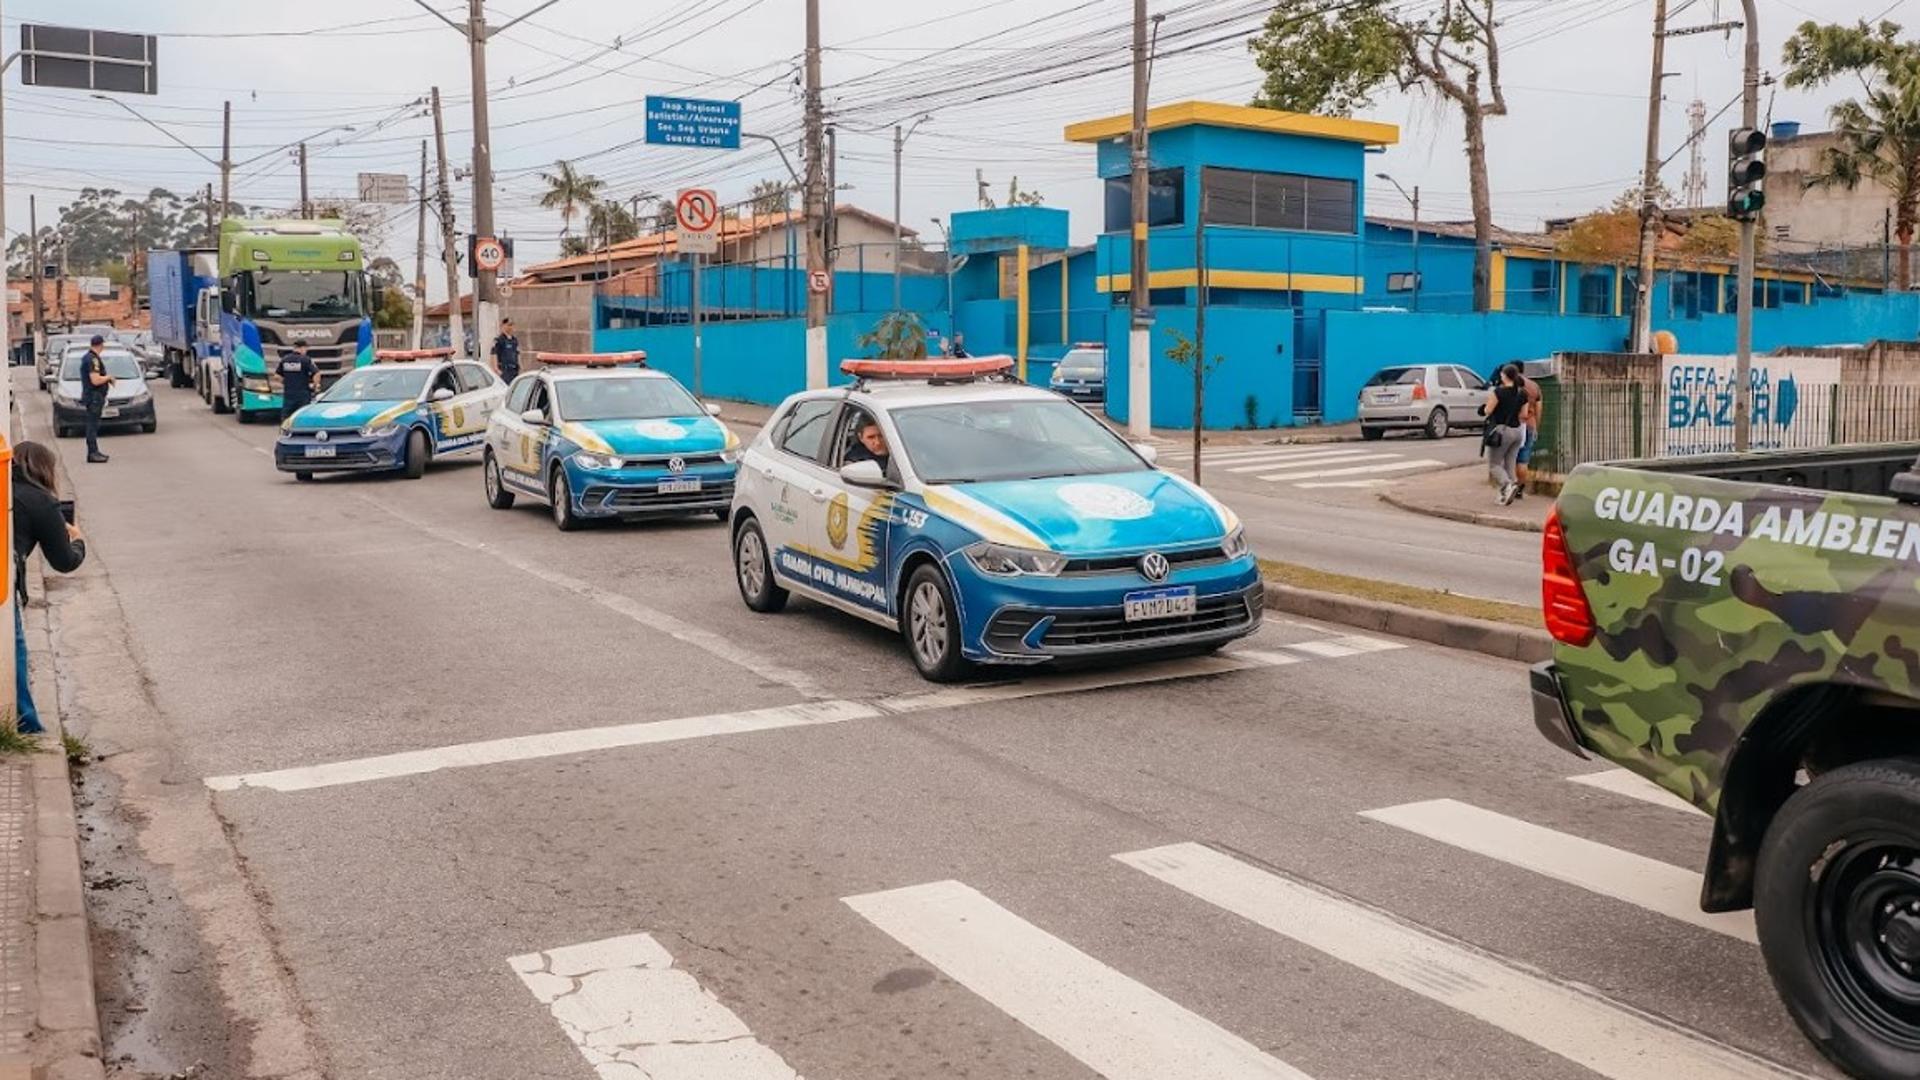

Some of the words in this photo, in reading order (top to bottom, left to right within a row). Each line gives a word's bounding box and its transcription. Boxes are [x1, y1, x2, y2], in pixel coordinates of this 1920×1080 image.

[686, 102, 725, 113] Regional
[698, 125, 729, 135] Urbana
[665, 134, 696, 143] Guarda
[700, 136, 721, 145] Civil
[480, 248, 499, 259] 40
[286, 329, 332, 338] SCANIA
[1670, 365, 1769, 391] GFFA-ARA
[1669, 393, 1770, 428] BAZR
[1594, 487, 1744, 537] GUARDA
[1750, 505, 1920, 560] AMBIEN
[1608, 538, 1725, 586] GA-02
[782, 552, 812, 578] GUARDA
[814, 565, 835, 587] CIVIL
[836, 572, 887, 604] MUNICIPAL
